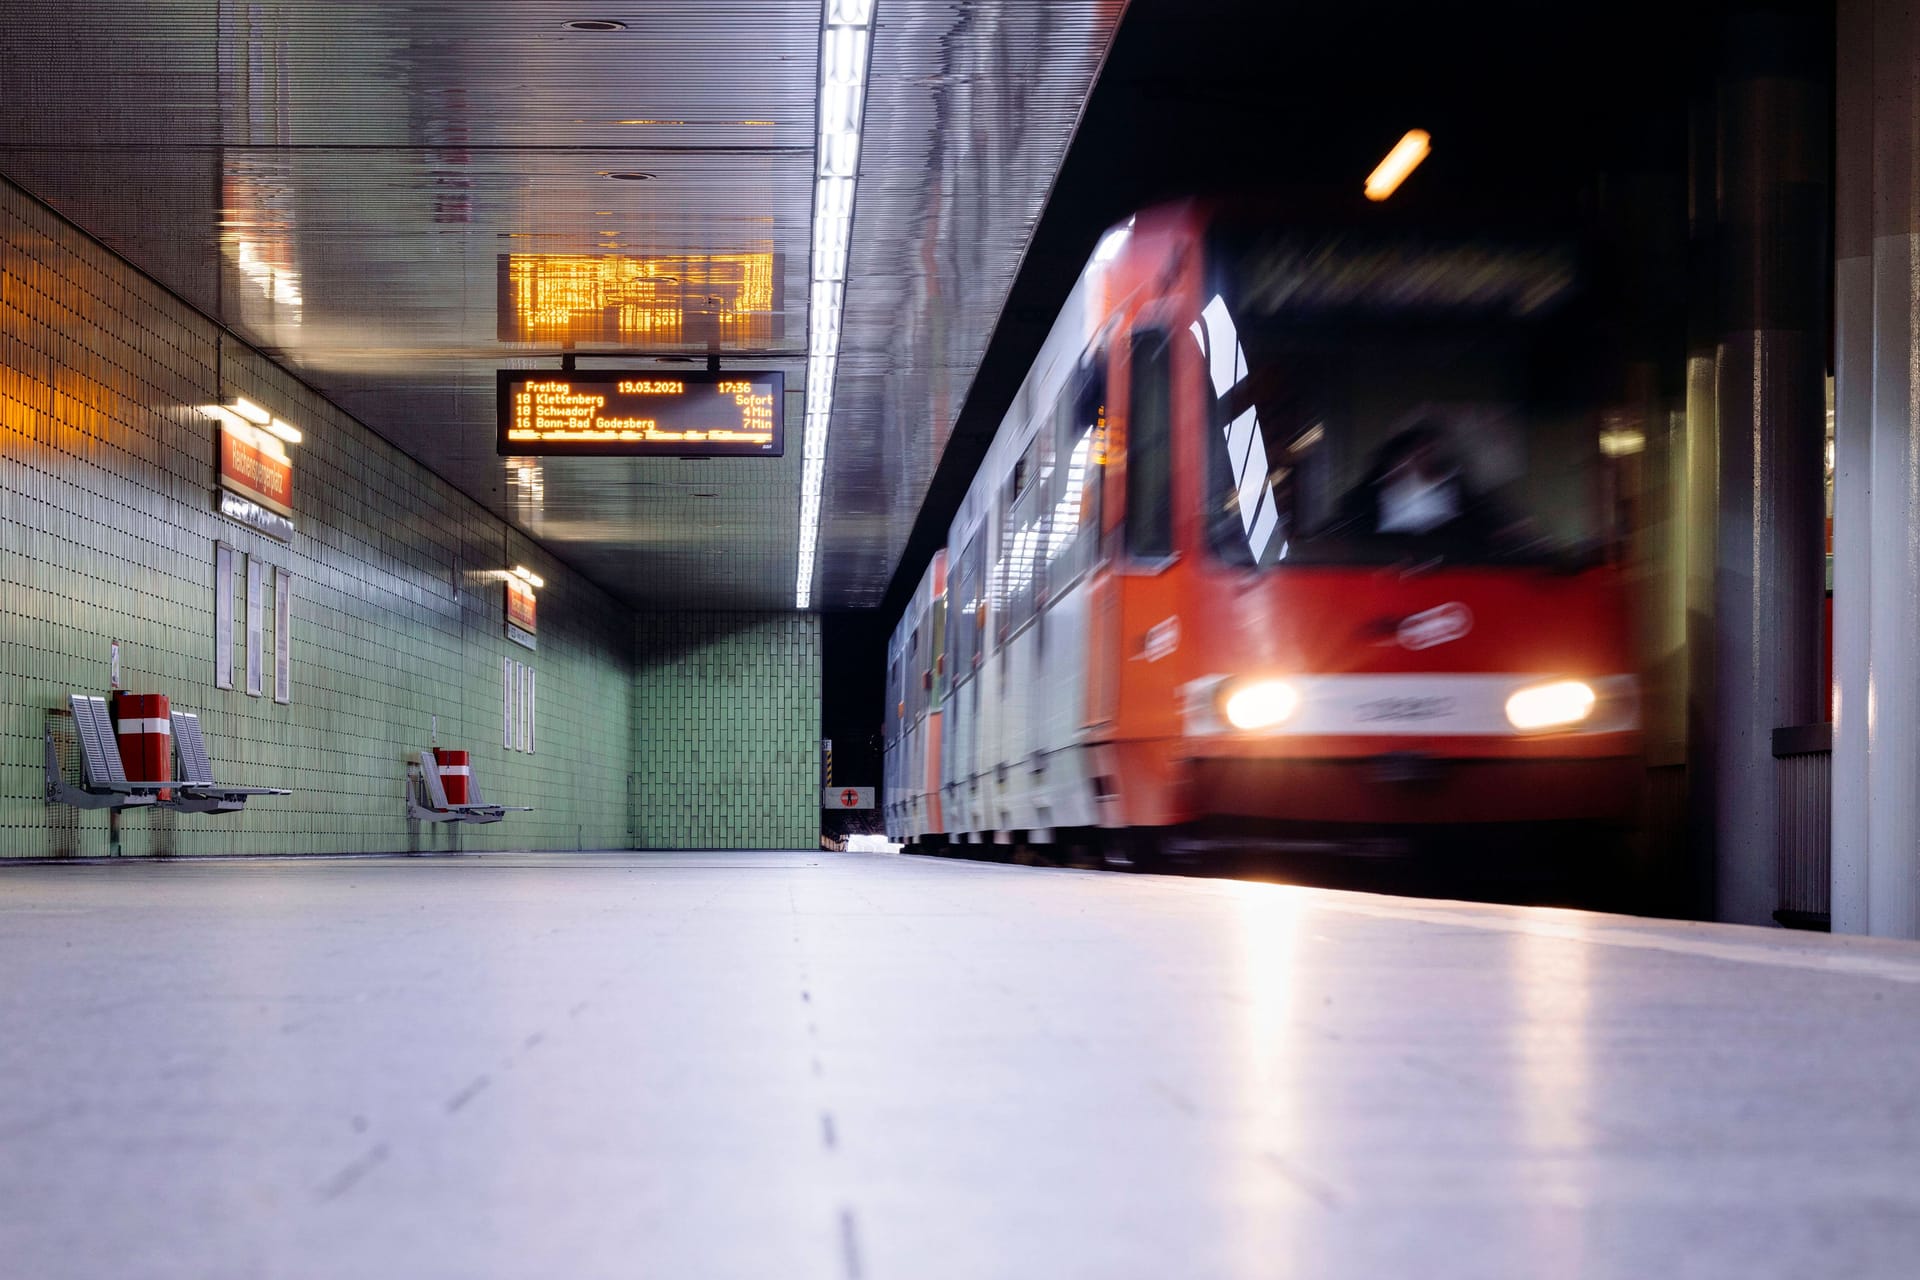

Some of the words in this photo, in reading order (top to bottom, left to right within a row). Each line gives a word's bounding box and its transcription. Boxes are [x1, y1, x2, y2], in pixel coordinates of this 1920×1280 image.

[526, 381, 569, 394] Freitag
[618, 382, 683, 393] 19.03.2021
[718, 382, 751, 393] 17:36
[516, 393, 531, 404] 18
[536, 393, 604, 407] Klettenberg
[735, 394, 773, 407] Sofort
[516, 405, 531, 416] 18
[536, 405, 596, 419] Schwadorf
[752, 407, 772, 417] Min
[516, 417, 531, 428] 16
[536, 417, 590, 428] Bonn-Bad
[596, 417, 655, 431] Godesberg
[752, 418, 772, 429] Min
